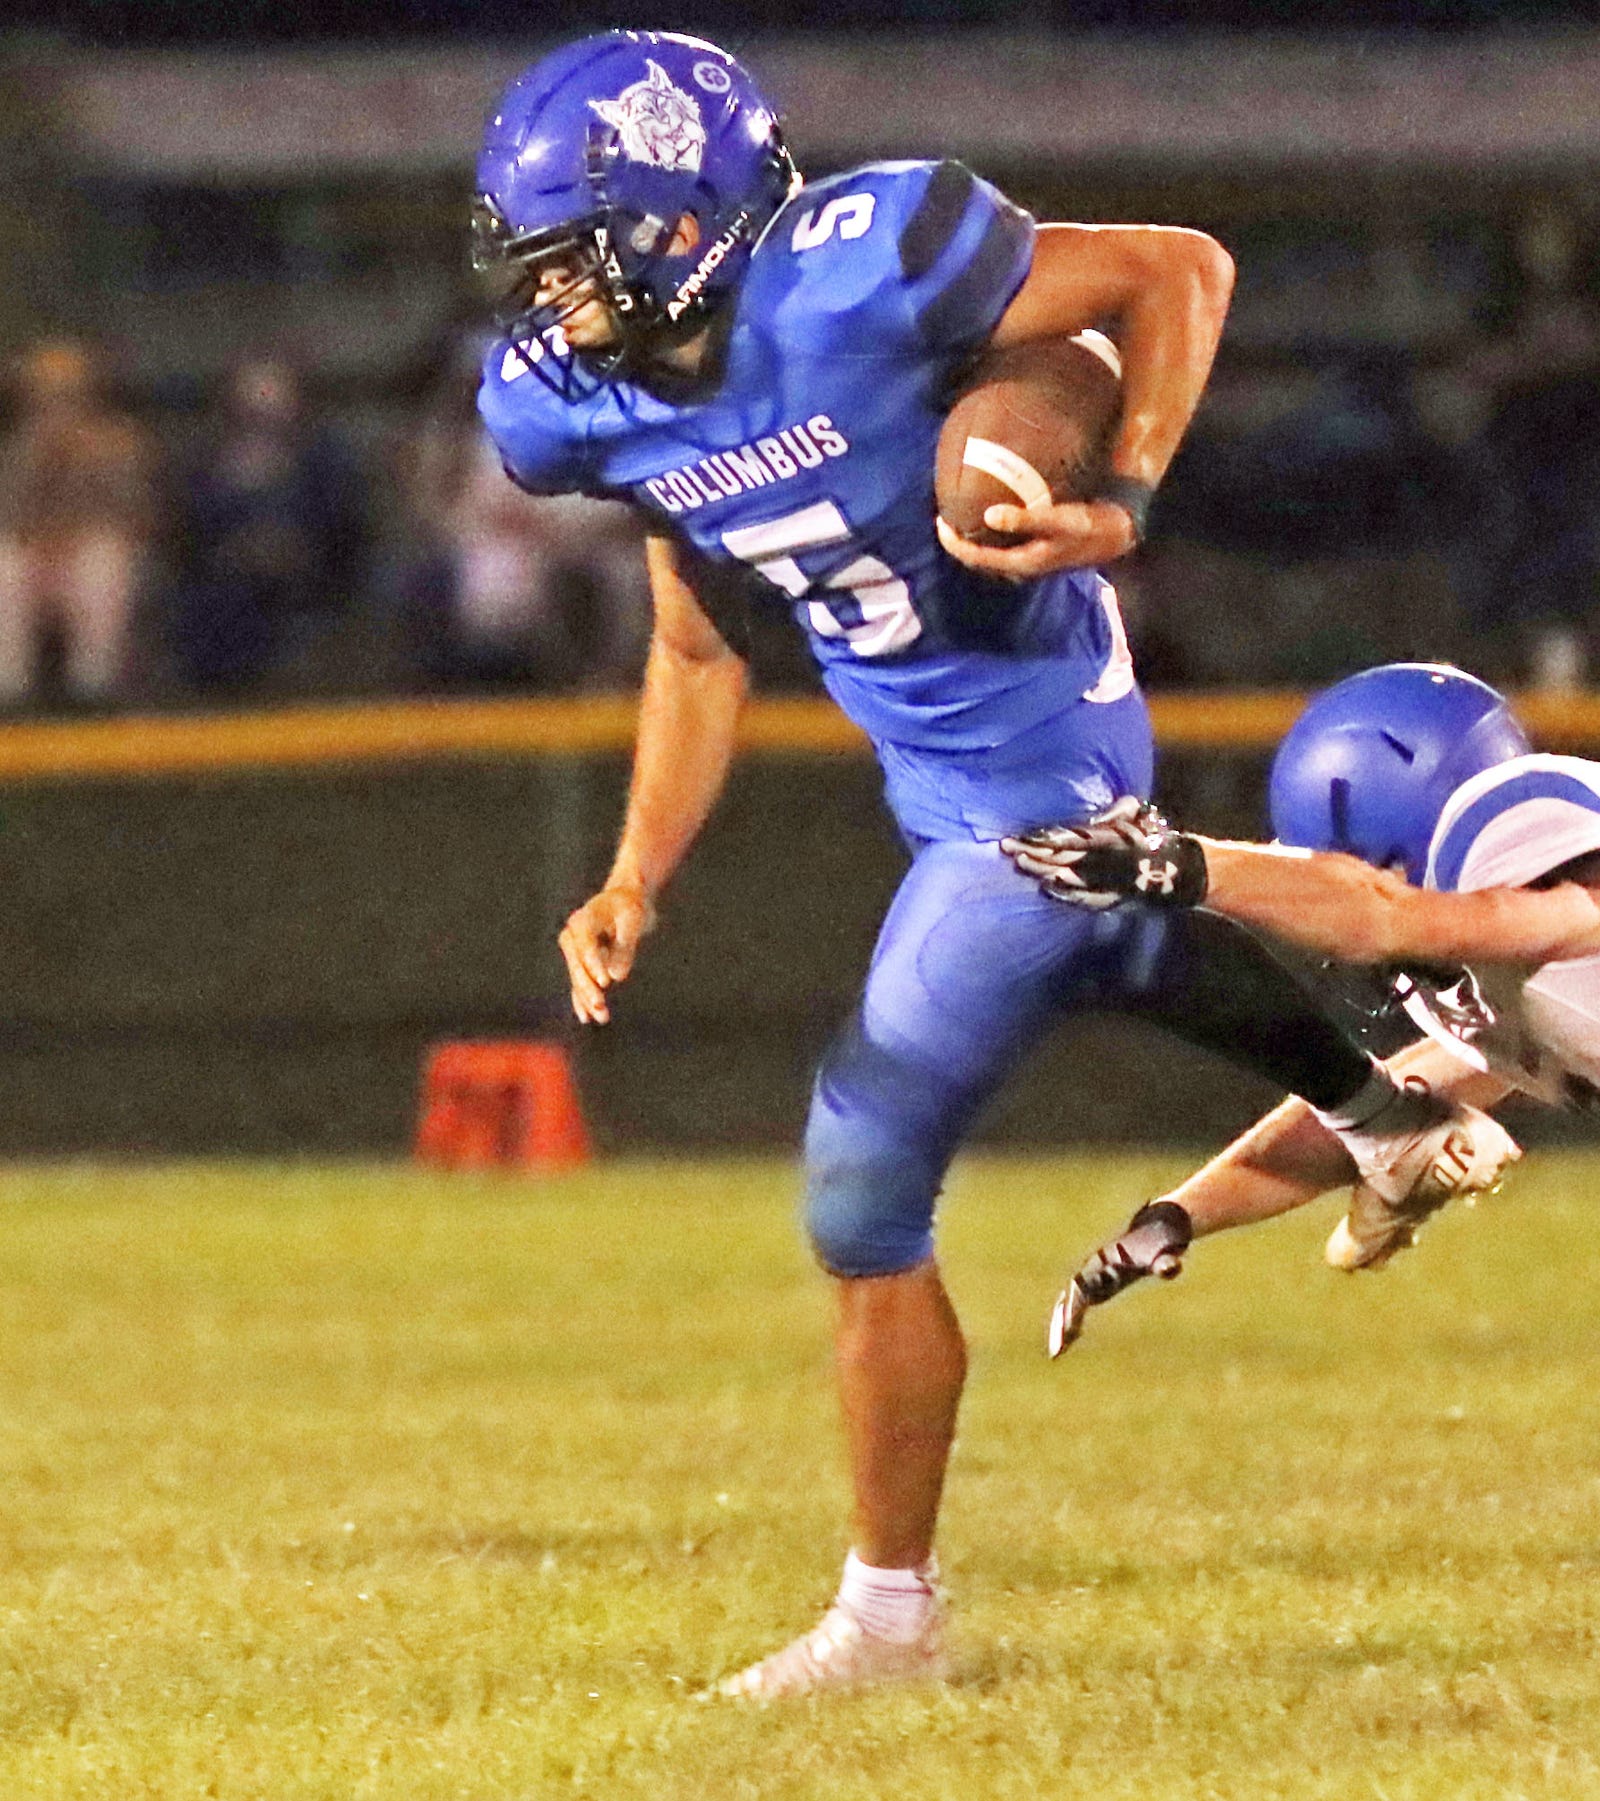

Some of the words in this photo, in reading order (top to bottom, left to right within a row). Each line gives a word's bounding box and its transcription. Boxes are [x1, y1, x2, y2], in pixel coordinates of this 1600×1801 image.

[791, 192, 876, 253] 5
[645, 415, 848, 512] COLUMBUS
[721, 500, 922, 656] 5
